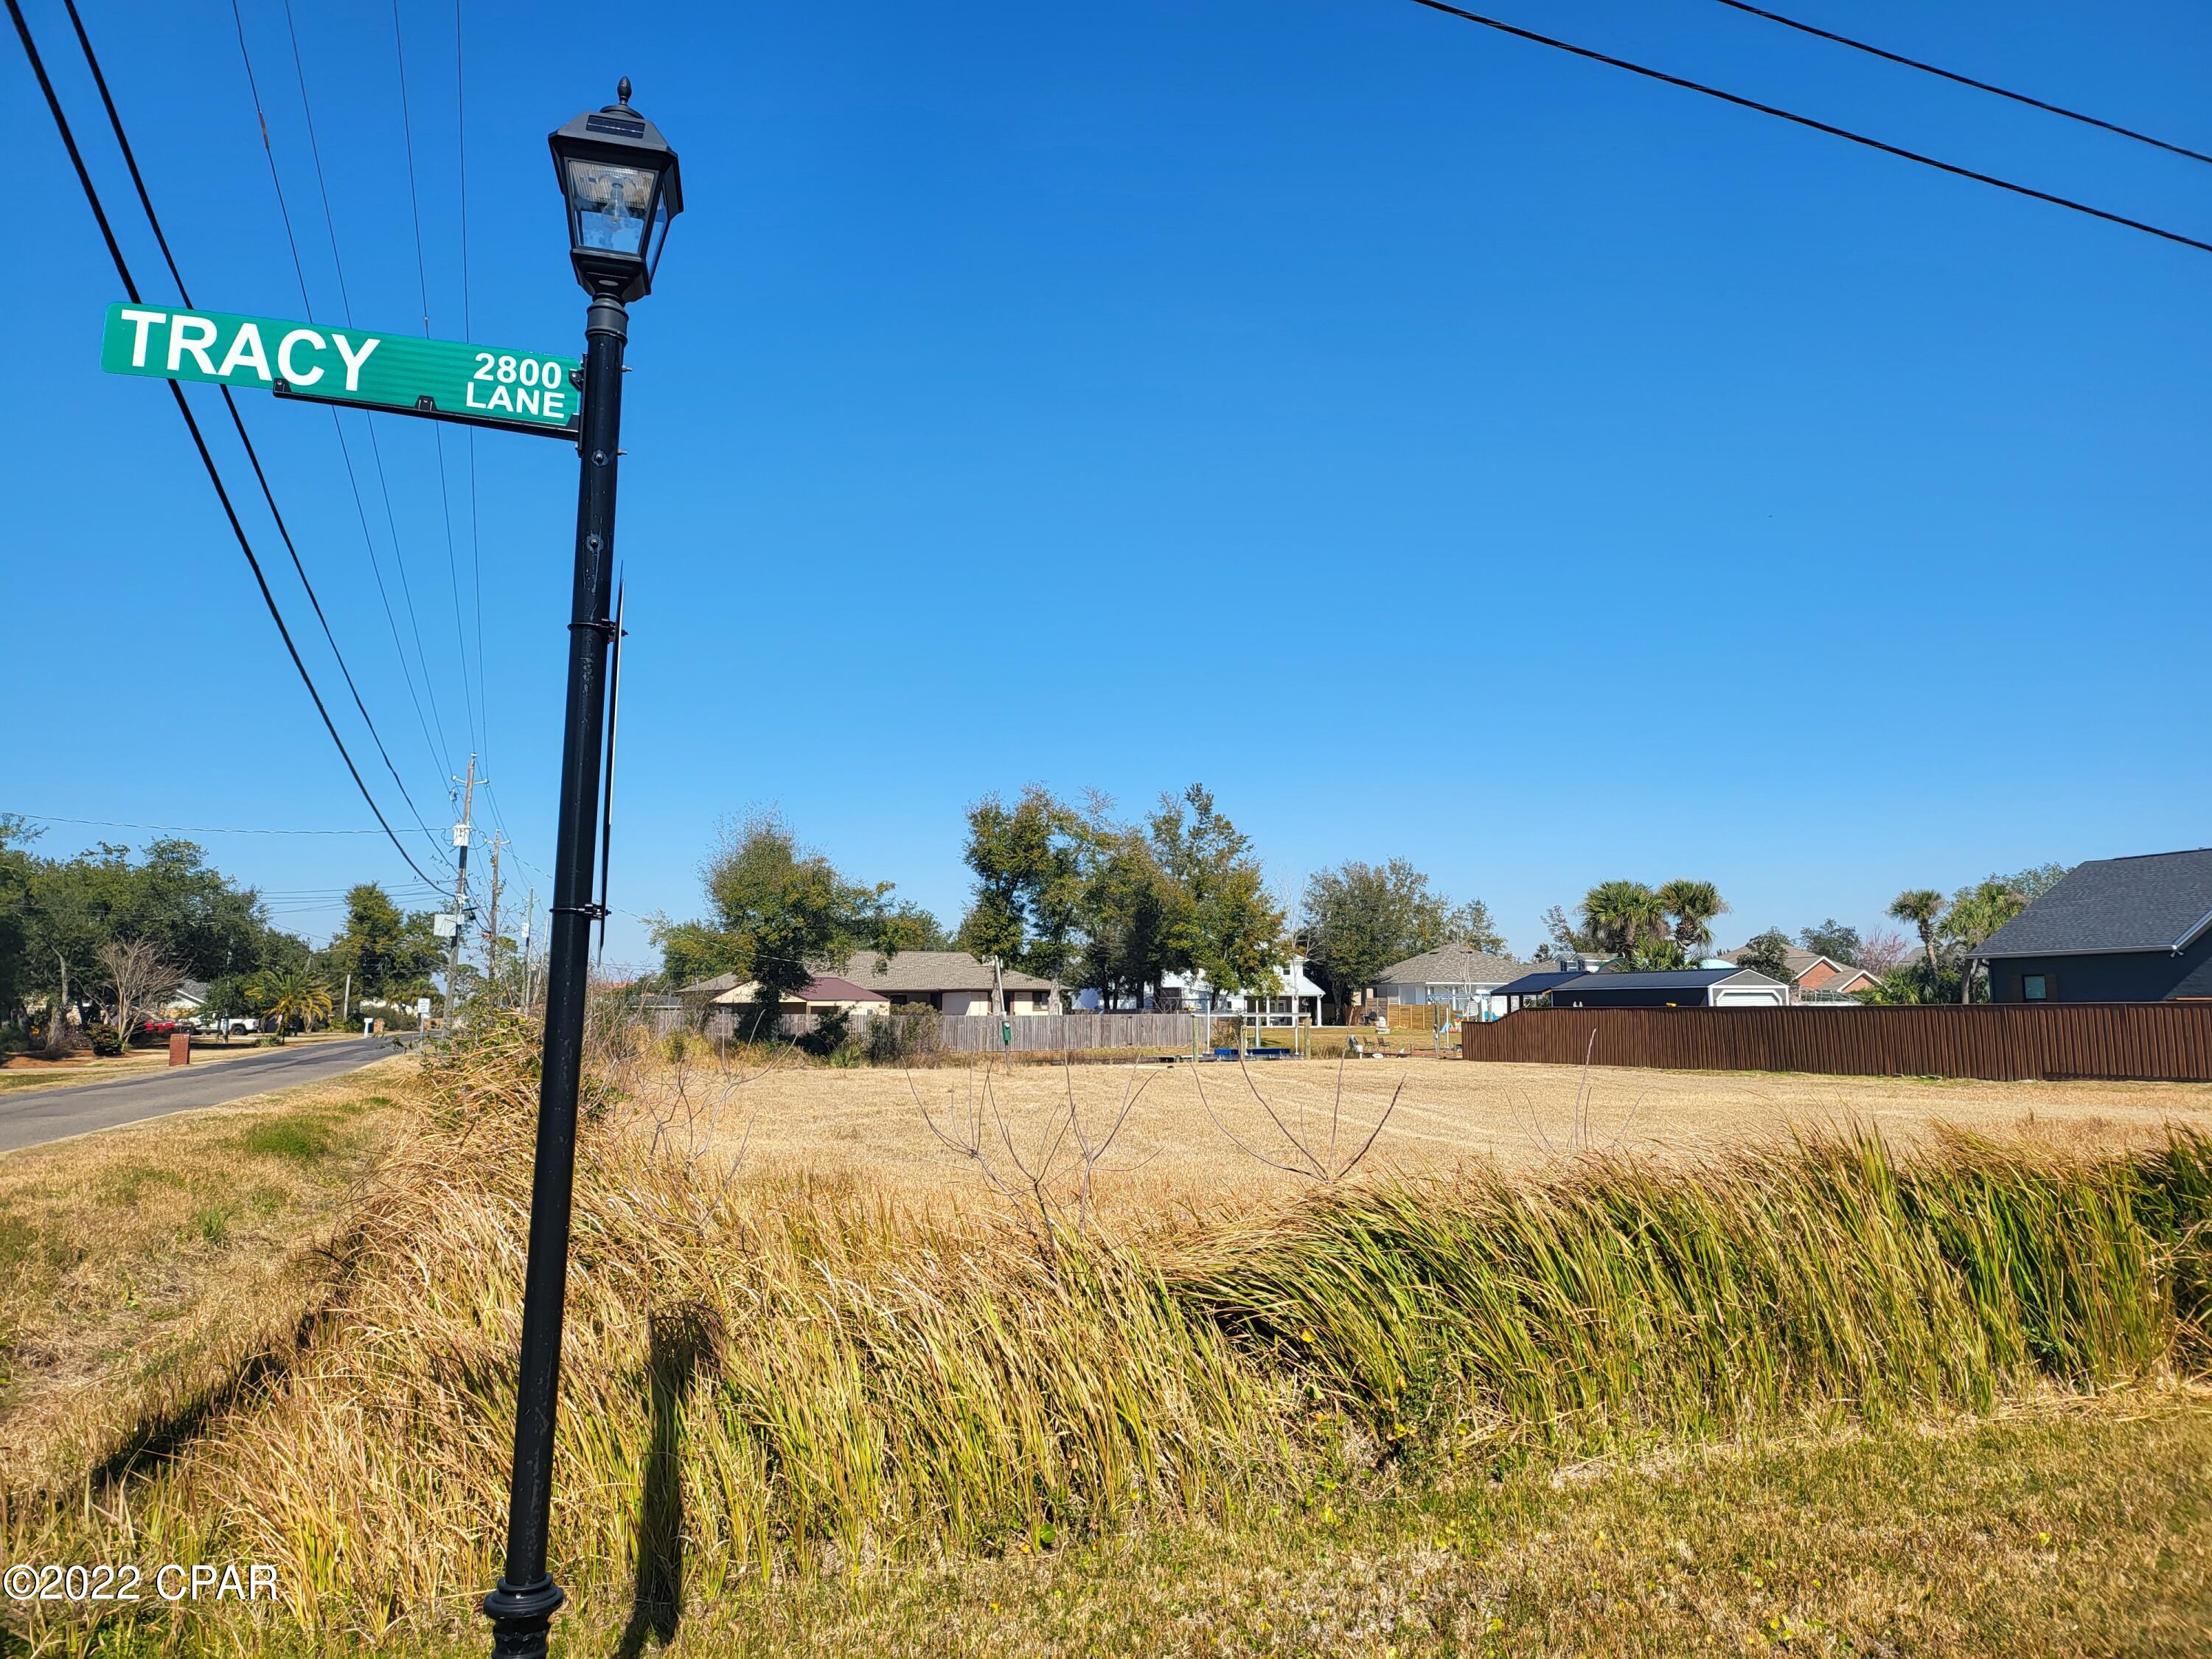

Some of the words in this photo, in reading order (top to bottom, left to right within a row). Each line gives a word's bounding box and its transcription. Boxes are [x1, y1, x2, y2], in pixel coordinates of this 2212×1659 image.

[120, 309, 381, 392] TRACY
[473, 352, 562, 389] 2800
[466, 381, 565, 419] LANE
